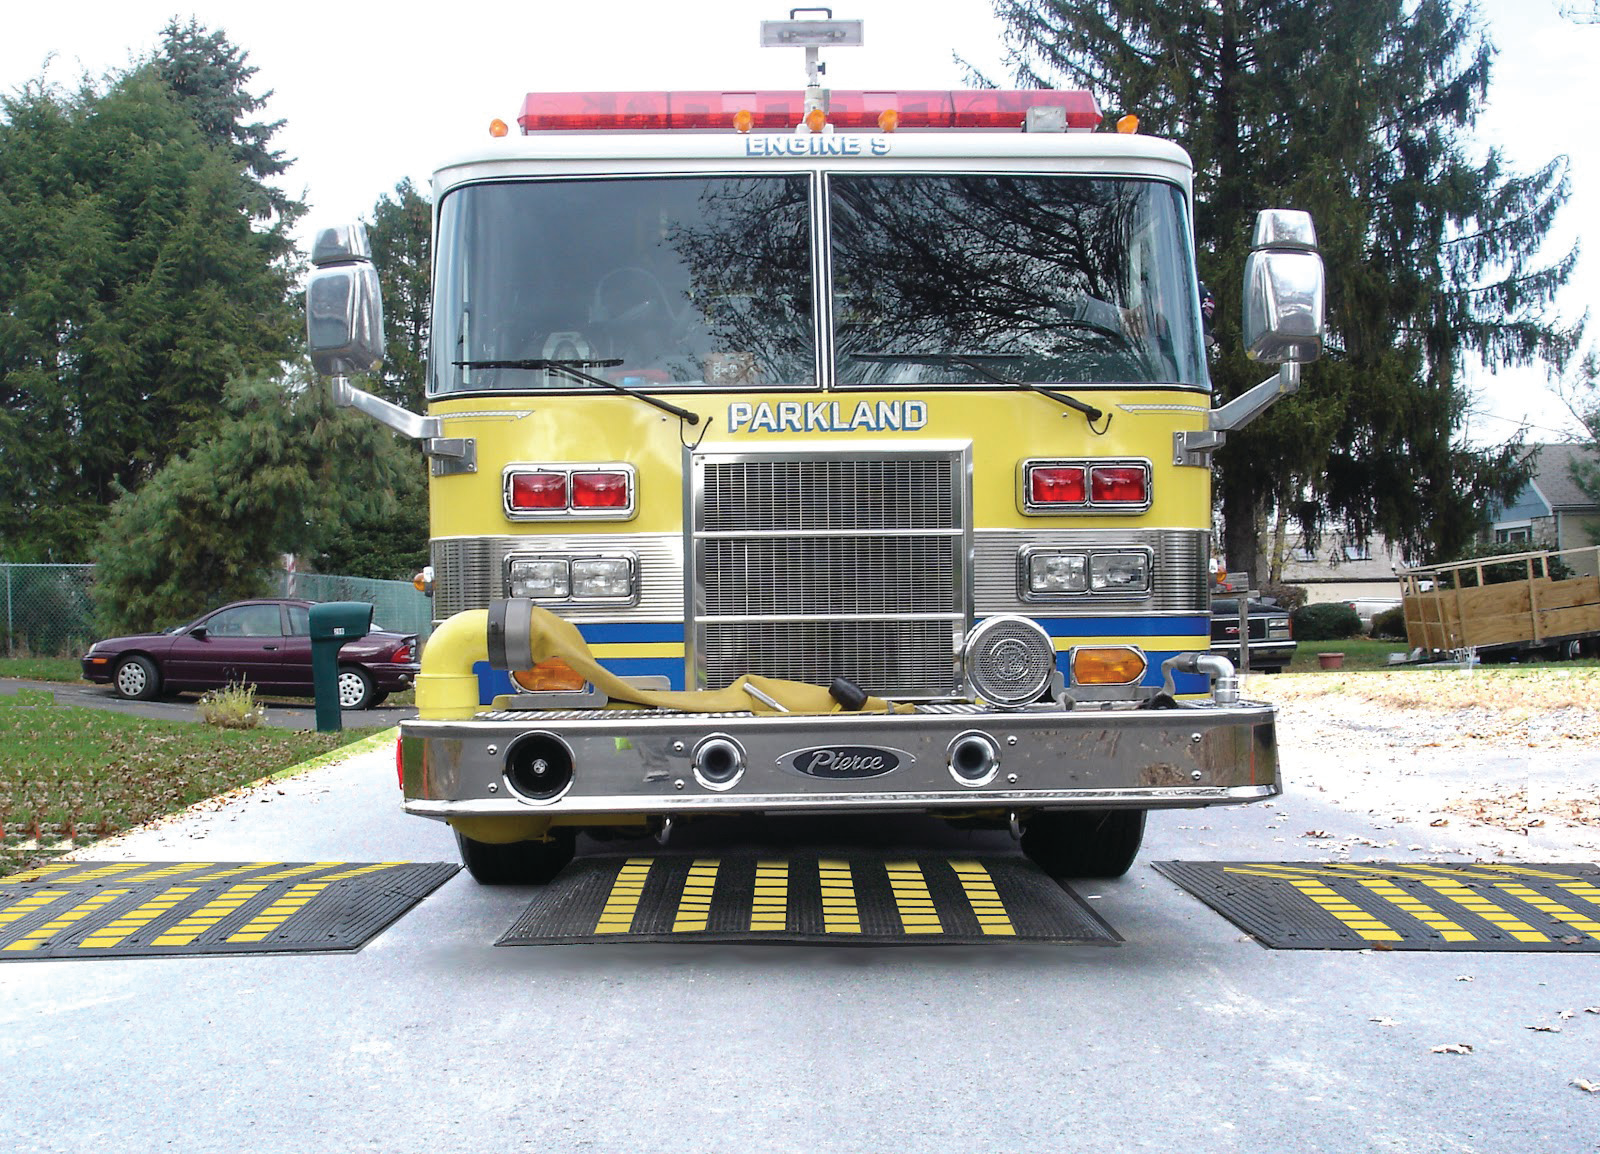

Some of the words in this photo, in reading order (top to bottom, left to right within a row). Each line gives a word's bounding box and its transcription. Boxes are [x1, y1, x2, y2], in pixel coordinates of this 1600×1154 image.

[745, 135, 861, 156] ENGINE
[727, 400, 928, 433] PARKLAND
[806, 749, 885, 775] Pierce
